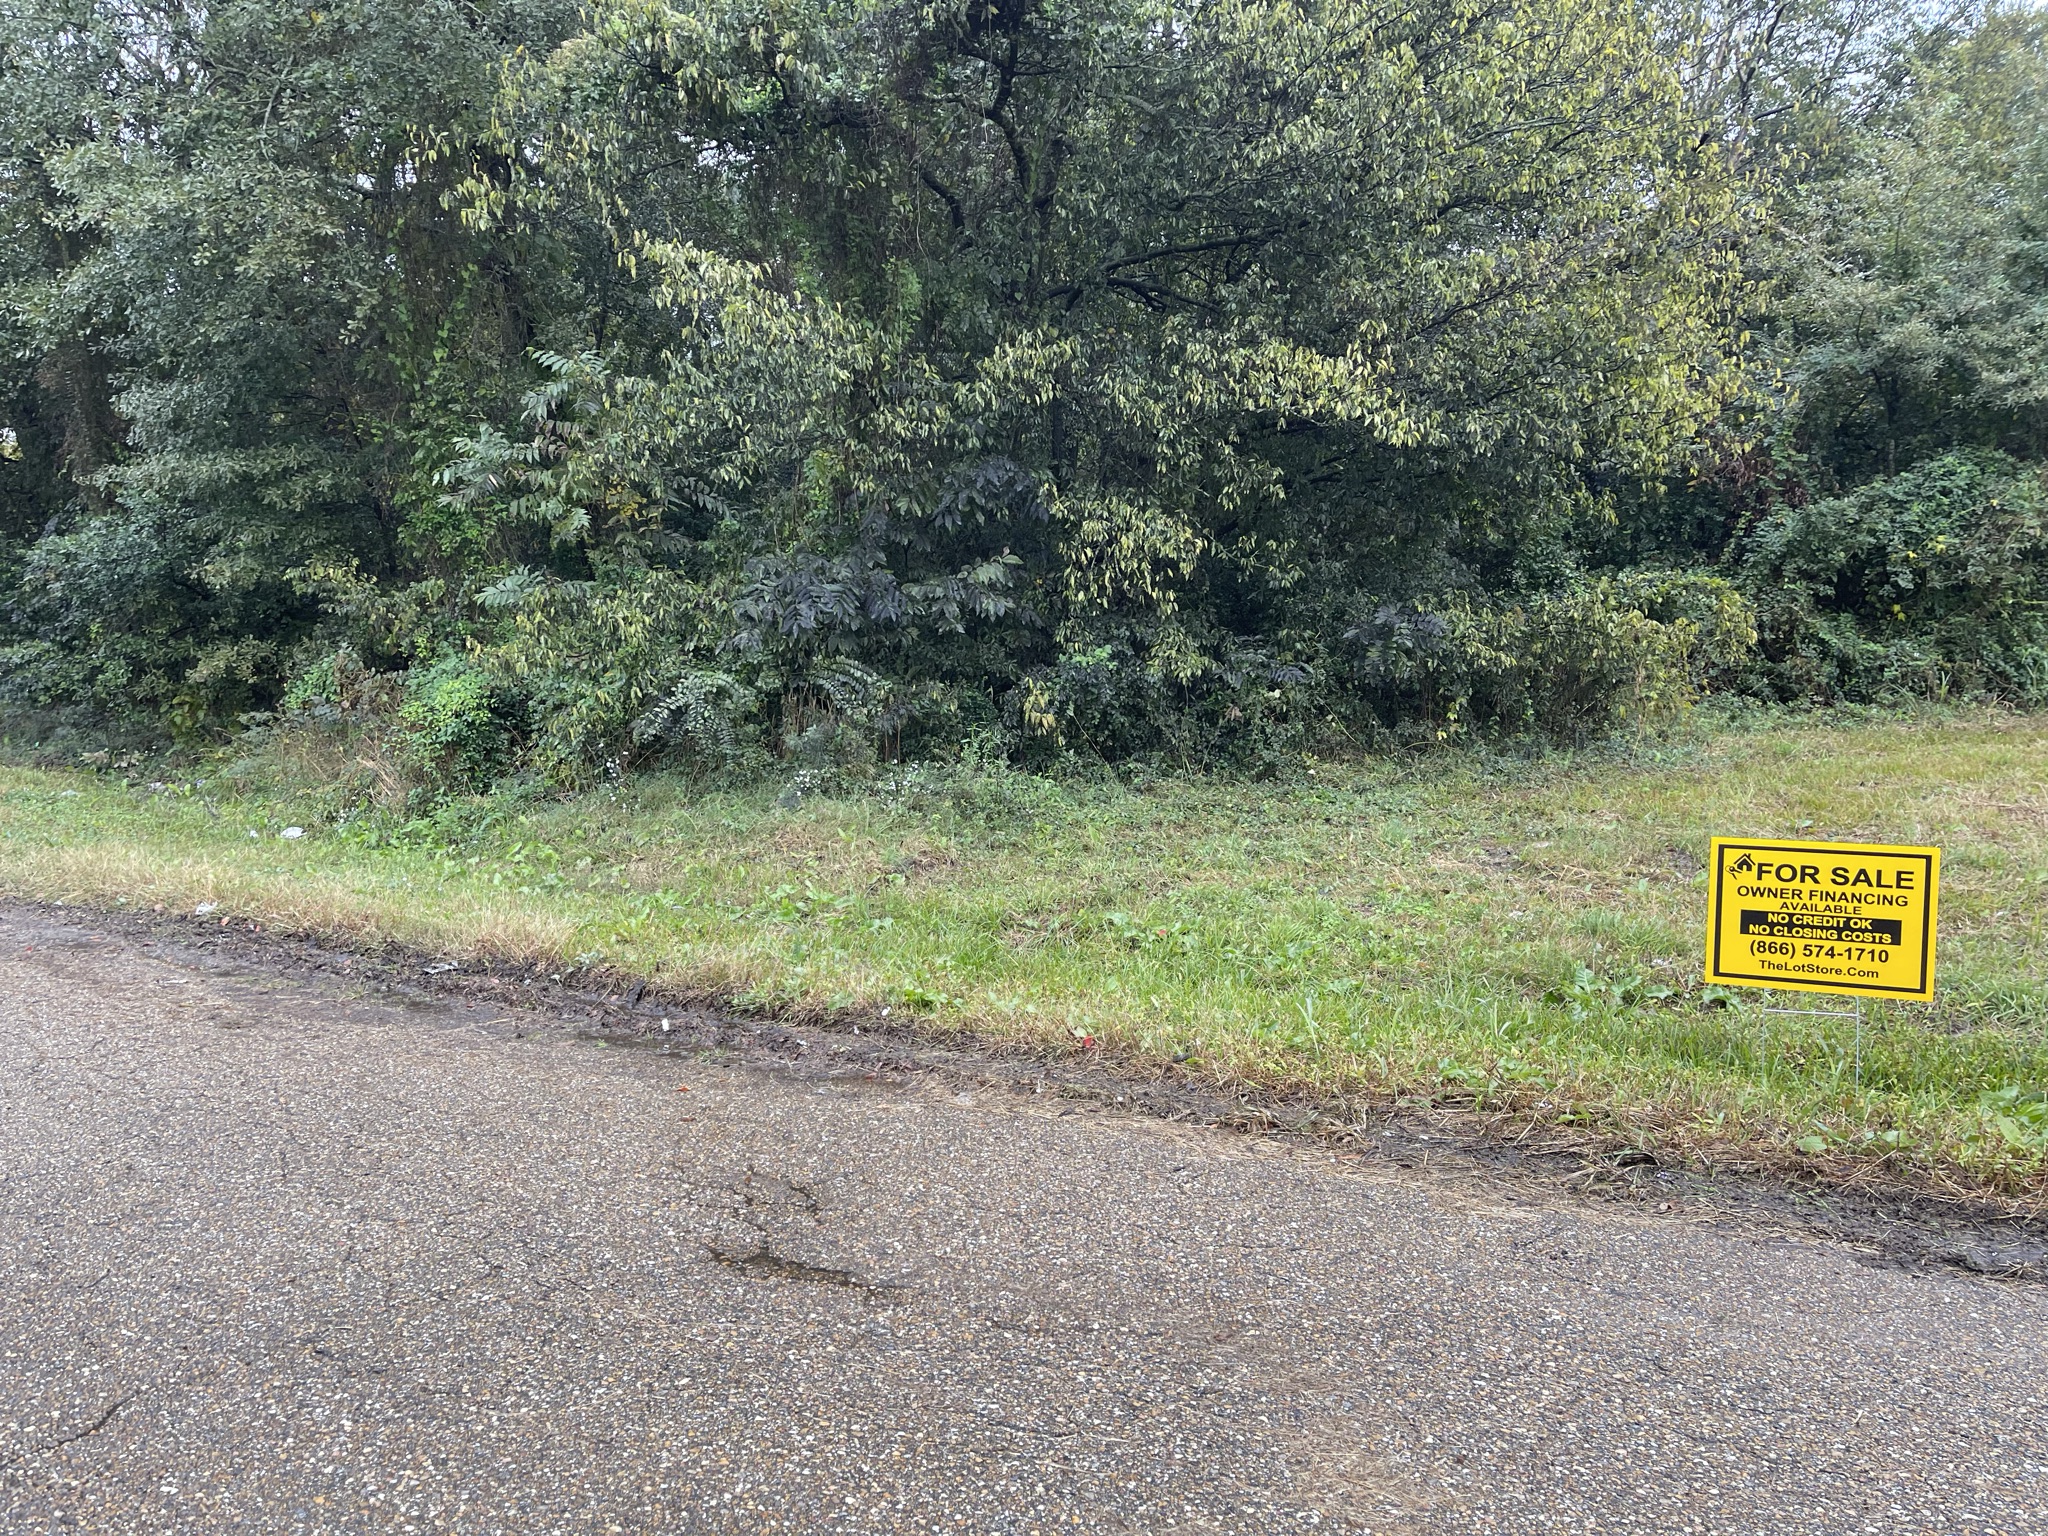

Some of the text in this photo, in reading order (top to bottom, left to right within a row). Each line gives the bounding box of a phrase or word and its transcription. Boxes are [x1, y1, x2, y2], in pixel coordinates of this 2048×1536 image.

[1757, 862, 1914, 890] FOR SALE
[1737, 885, 1908, 906] OWNER FINANCING
[1780, 902, 1862, 915] AVAILABLE
[1768, 913, 1872, 929] NO CREDIT OK
[1749, 925, 1892, 943] NO CLOSING COSTS
[1750, 940, 1889, 963] (866) 574-1710
[1759, 960, 1879, 978] TheLotStore.Com
